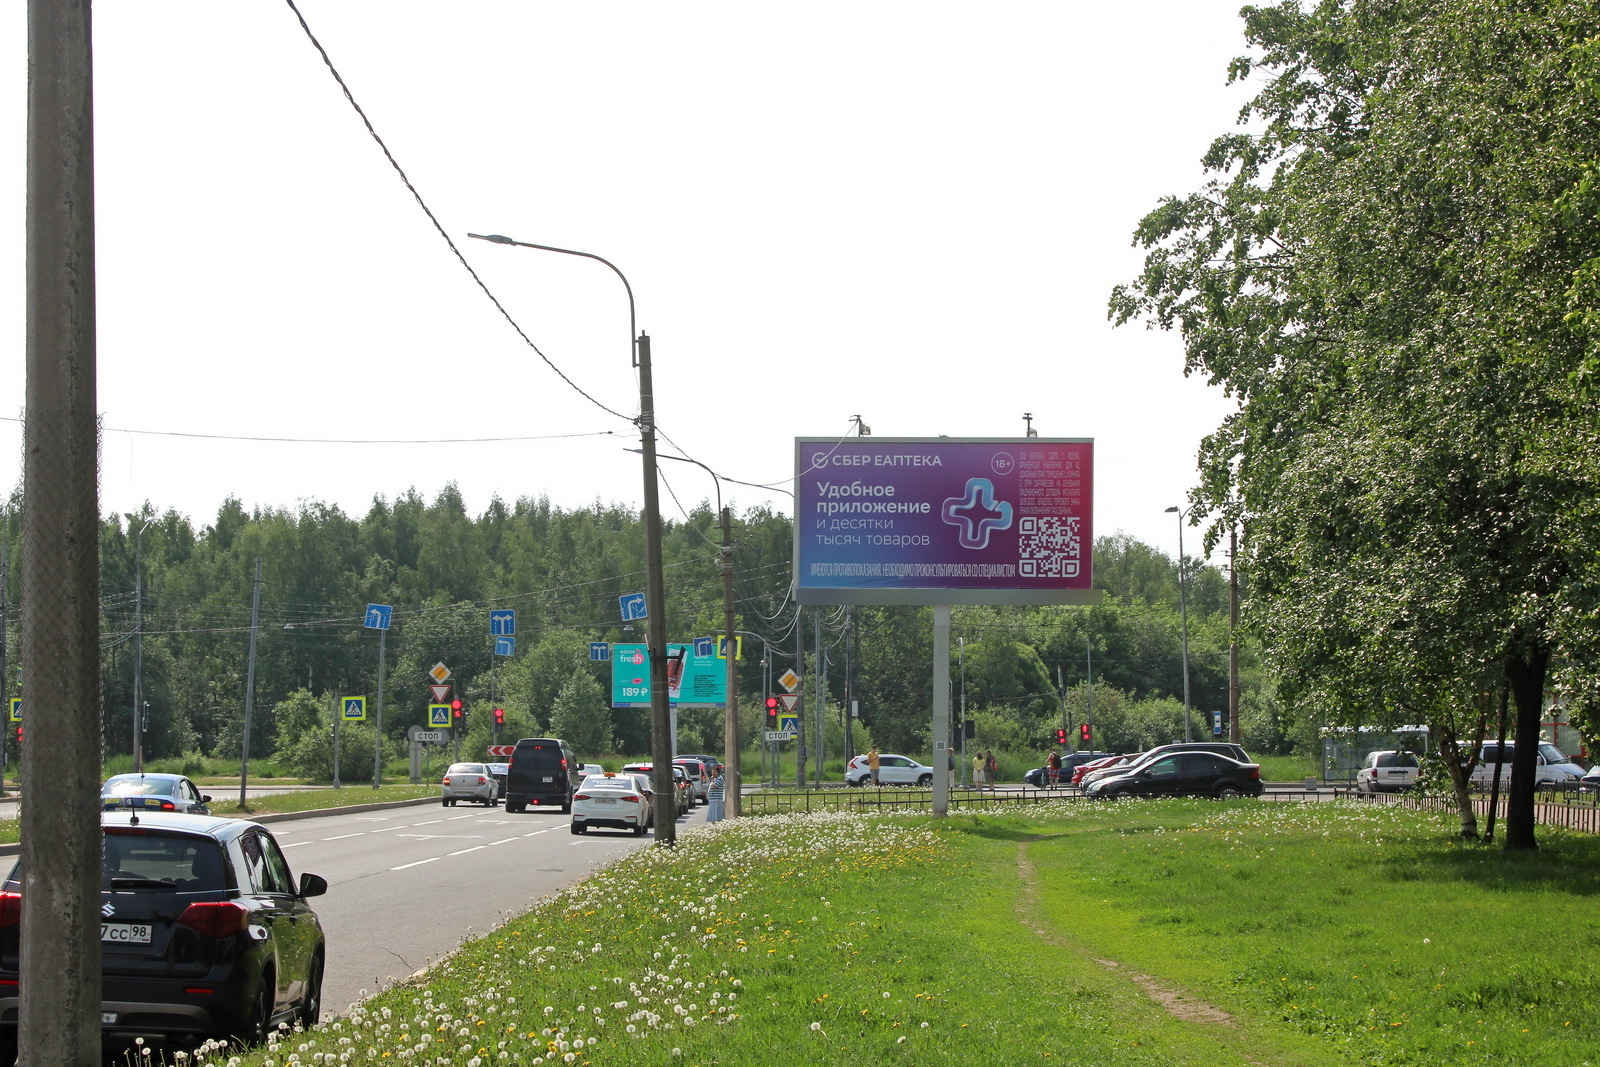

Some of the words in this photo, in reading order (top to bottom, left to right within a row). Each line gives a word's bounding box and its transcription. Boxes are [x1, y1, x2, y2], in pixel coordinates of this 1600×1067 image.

[832, 454, 871, 467] СБЕР
[875, 454, 942, 467] ЕАПТЕКА
[995, 459, 1011, 468] 18+
[817, 481, 895, 498] Удобное
[817, 500, 931, 516] приложение
[817, 519, 826, 529] и
[830, 518, 894, 532] десятки
[816, 533, 863, 546] тысяч
[865, 533, 930, 548] товаров
[620, 654, 642, 663] fresh
[622, 687, 640, 697] 189
[417, 731, 439, 740] СТОП
[768, 732, 788, 740] СТОП
[132, 925, 147, 937] 98
